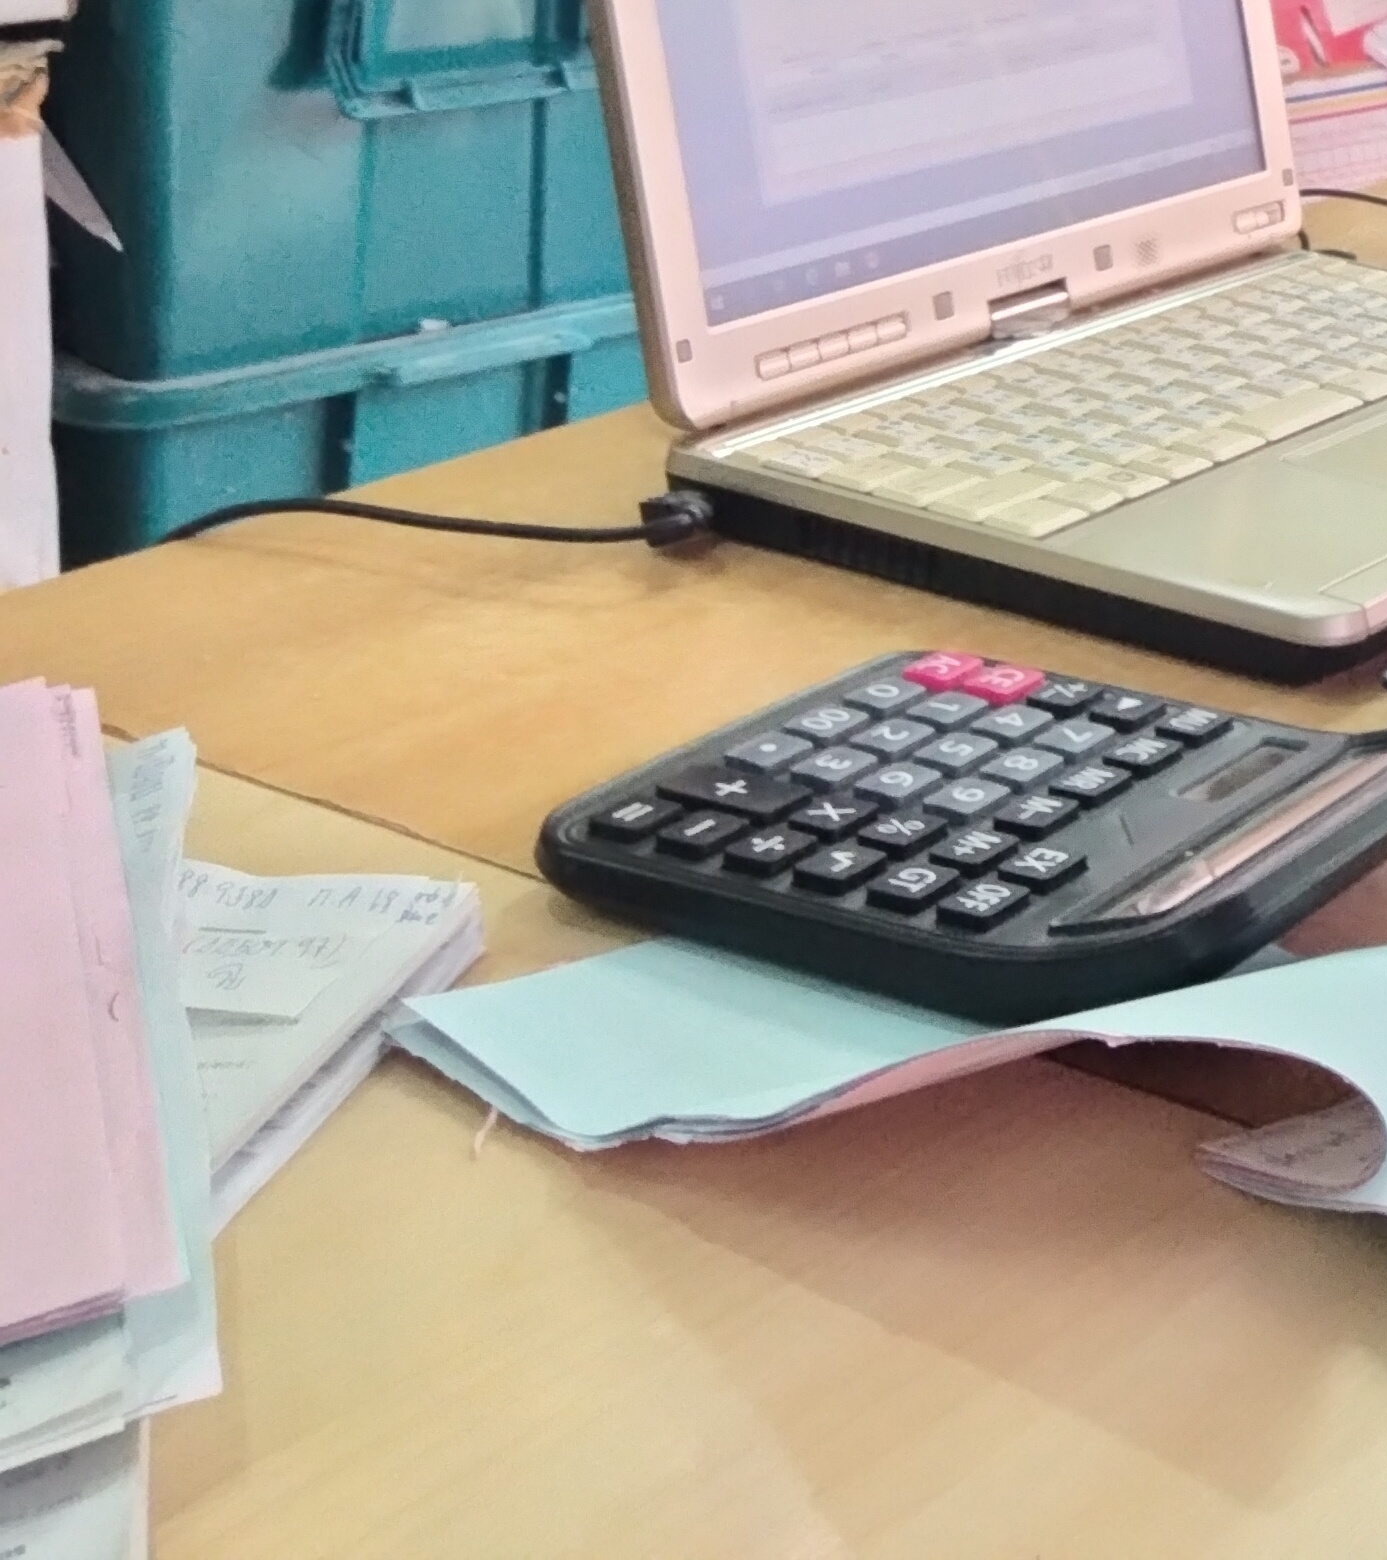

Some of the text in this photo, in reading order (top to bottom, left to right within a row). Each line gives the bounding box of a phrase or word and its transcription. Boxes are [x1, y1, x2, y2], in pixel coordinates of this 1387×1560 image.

[866, 683, 900, 698] 0
[928, 701, 960, 713] 1
[801, 708, 850, 731] 00
[994, 712, 1023, 729] 4
[876, 726, 910, 742] 2
[1062, 726, 1092, 742] 7
[940, 740, 974, 757] 5
[1116, 737, 1168, 761] MC
[814, 753, 852, 771] 3
[1004, 754, 1039, 772] 8
[880, 771, 914, 789] 6
[1063, 766, 1117, 790] MR
[952, 786, 986, 803] 9
[1015, 846, 1069, 873] EX
[889, 867, 937, 894] GT
[957, 883, 1011, 913] OFF
